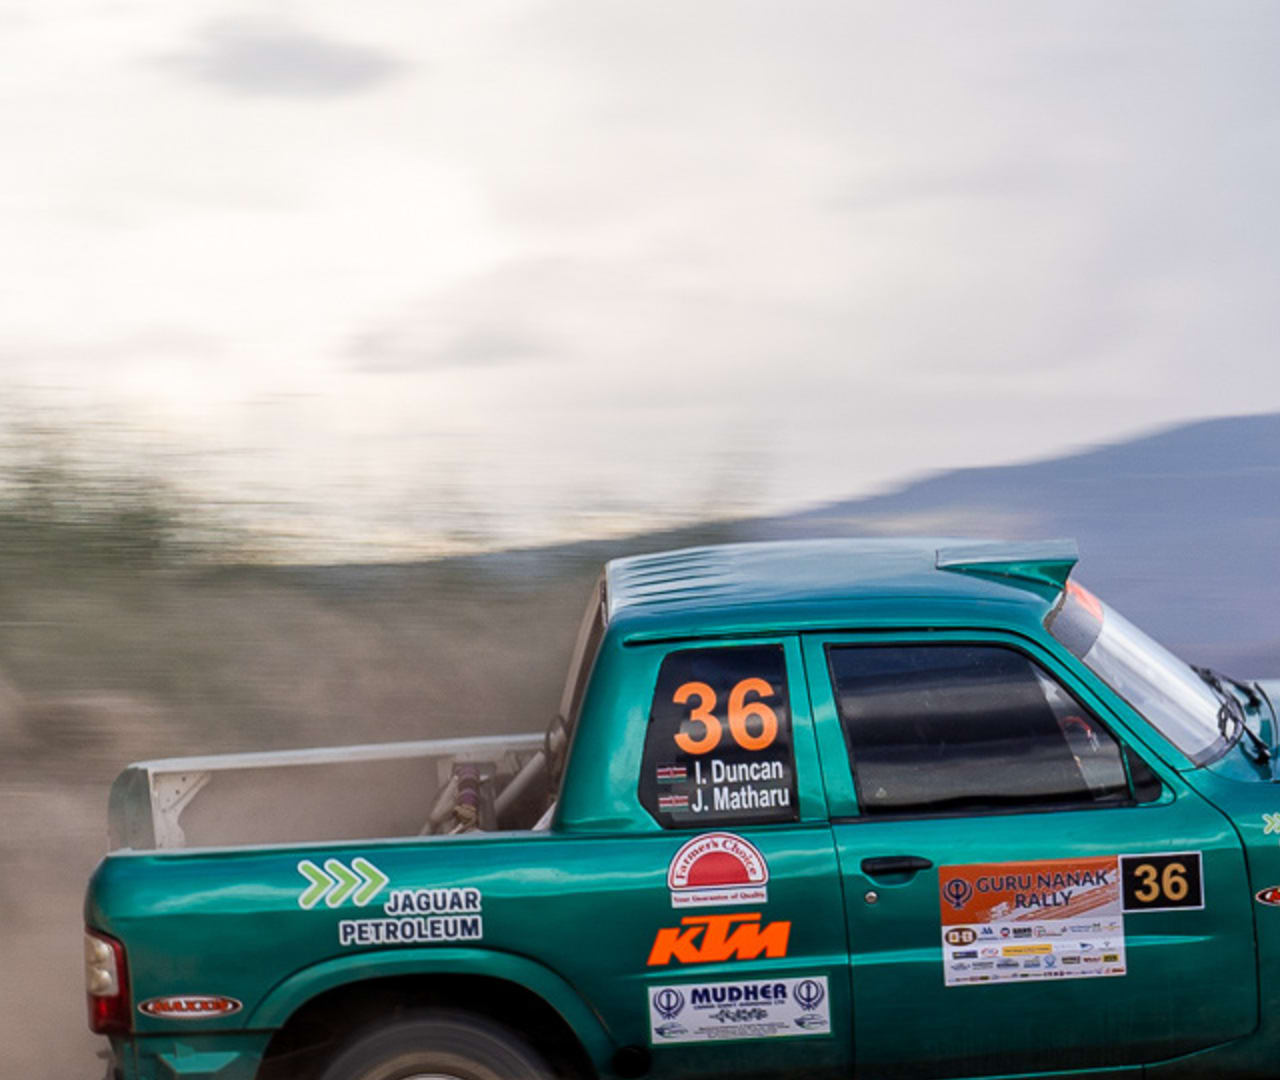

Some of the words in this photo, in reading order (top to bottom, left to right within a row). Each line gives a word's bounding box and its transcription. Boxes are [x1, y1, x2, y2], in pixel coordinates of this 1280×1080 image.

[672, 677, 779, 755] 36
[694, 761, 707, 785] I.
[711, 760, 783, 783] Duncan
[691, 788, 709, 813] J.
[713, 784, 790, 811] Matharu
[720, 839, 758, 876] Choice
[975, 874, 1032, 894] GURU
[1036, 870, 1109, 889] NANAK
[1133, 863, 1189, 903] 36
[386, 890, 479, 914] JAGUAR
[1013, 890, 1073, 909] RALLY
[340, 917, 481, 943] PETROLEUM
[646, 912, 791, 966] KTM
[690, 983, 787, 1004] MUDHER
